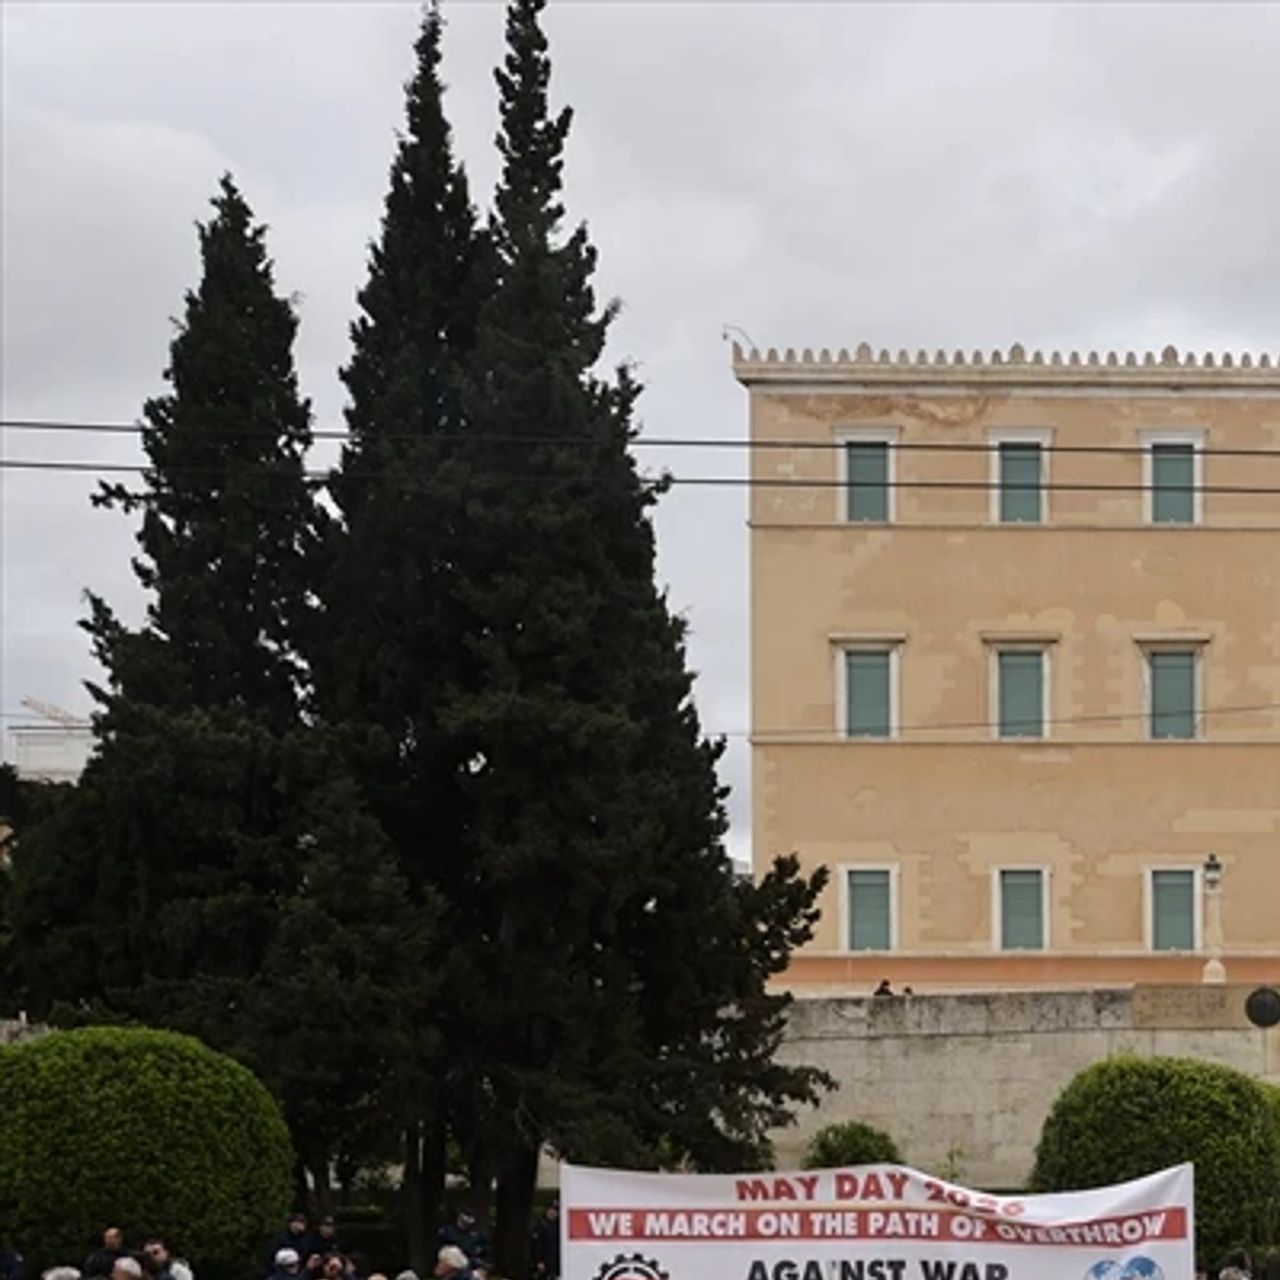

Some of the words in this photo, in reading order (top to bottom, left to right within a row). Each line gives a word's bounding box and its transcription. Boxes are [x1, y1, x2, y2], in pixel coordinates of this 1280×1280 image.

[736, 1177, 818, 1200] MAY
[834, 1174, 910, 1200] DAY
[589, 1213, 633, 1236] WE
[643, 1213, 746, 1236] MARCH
[757, 1213, 799, 1236] ON
[810, 1213, 858, 1236] THE
[869, 1212, 939, 1236] PATH
[1000, 1213, 1166, 1242] OVERTHROW
